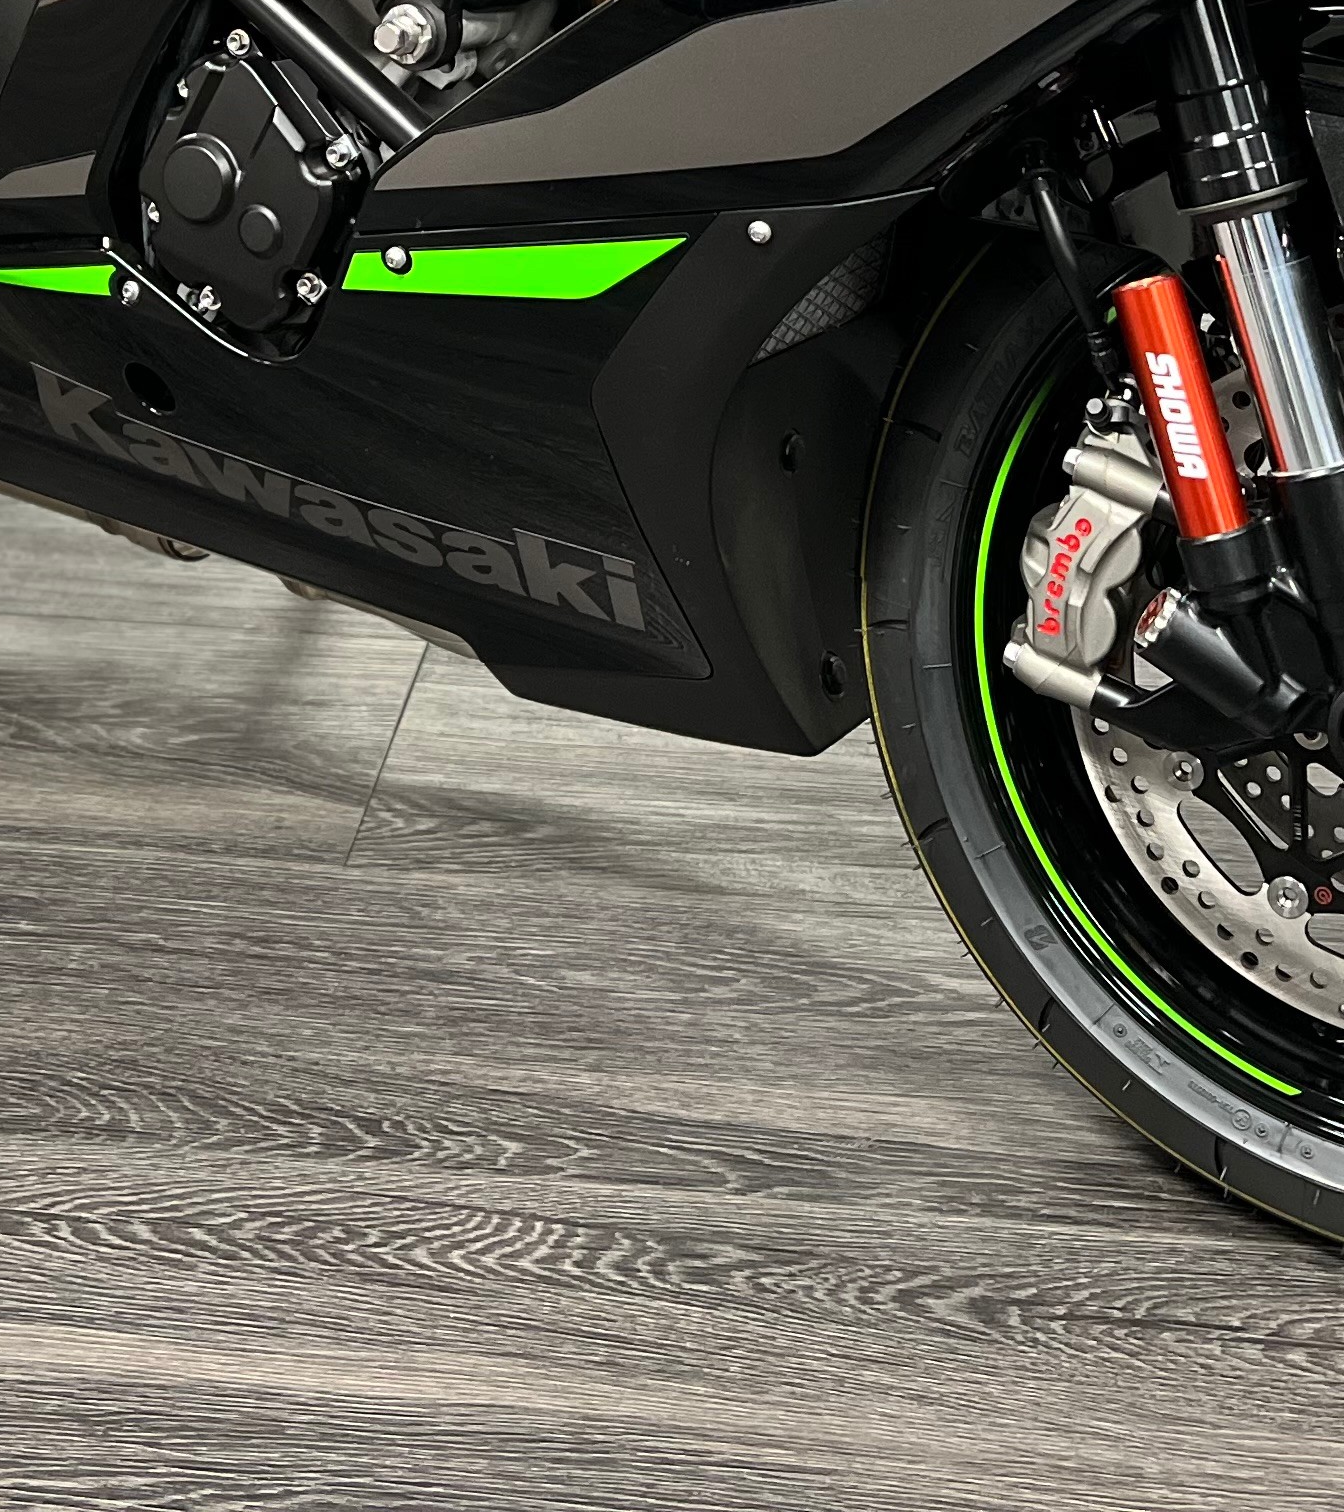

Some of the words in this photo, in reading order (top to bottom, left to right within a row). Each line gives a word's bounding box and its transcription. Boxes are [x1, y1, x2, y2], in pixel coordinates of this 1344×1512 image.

[1145, 351, 1208, 480] SHOWA
[30, 361, 646, 632] Kawasaki
[1036, 517, 1093, 637] brembo
